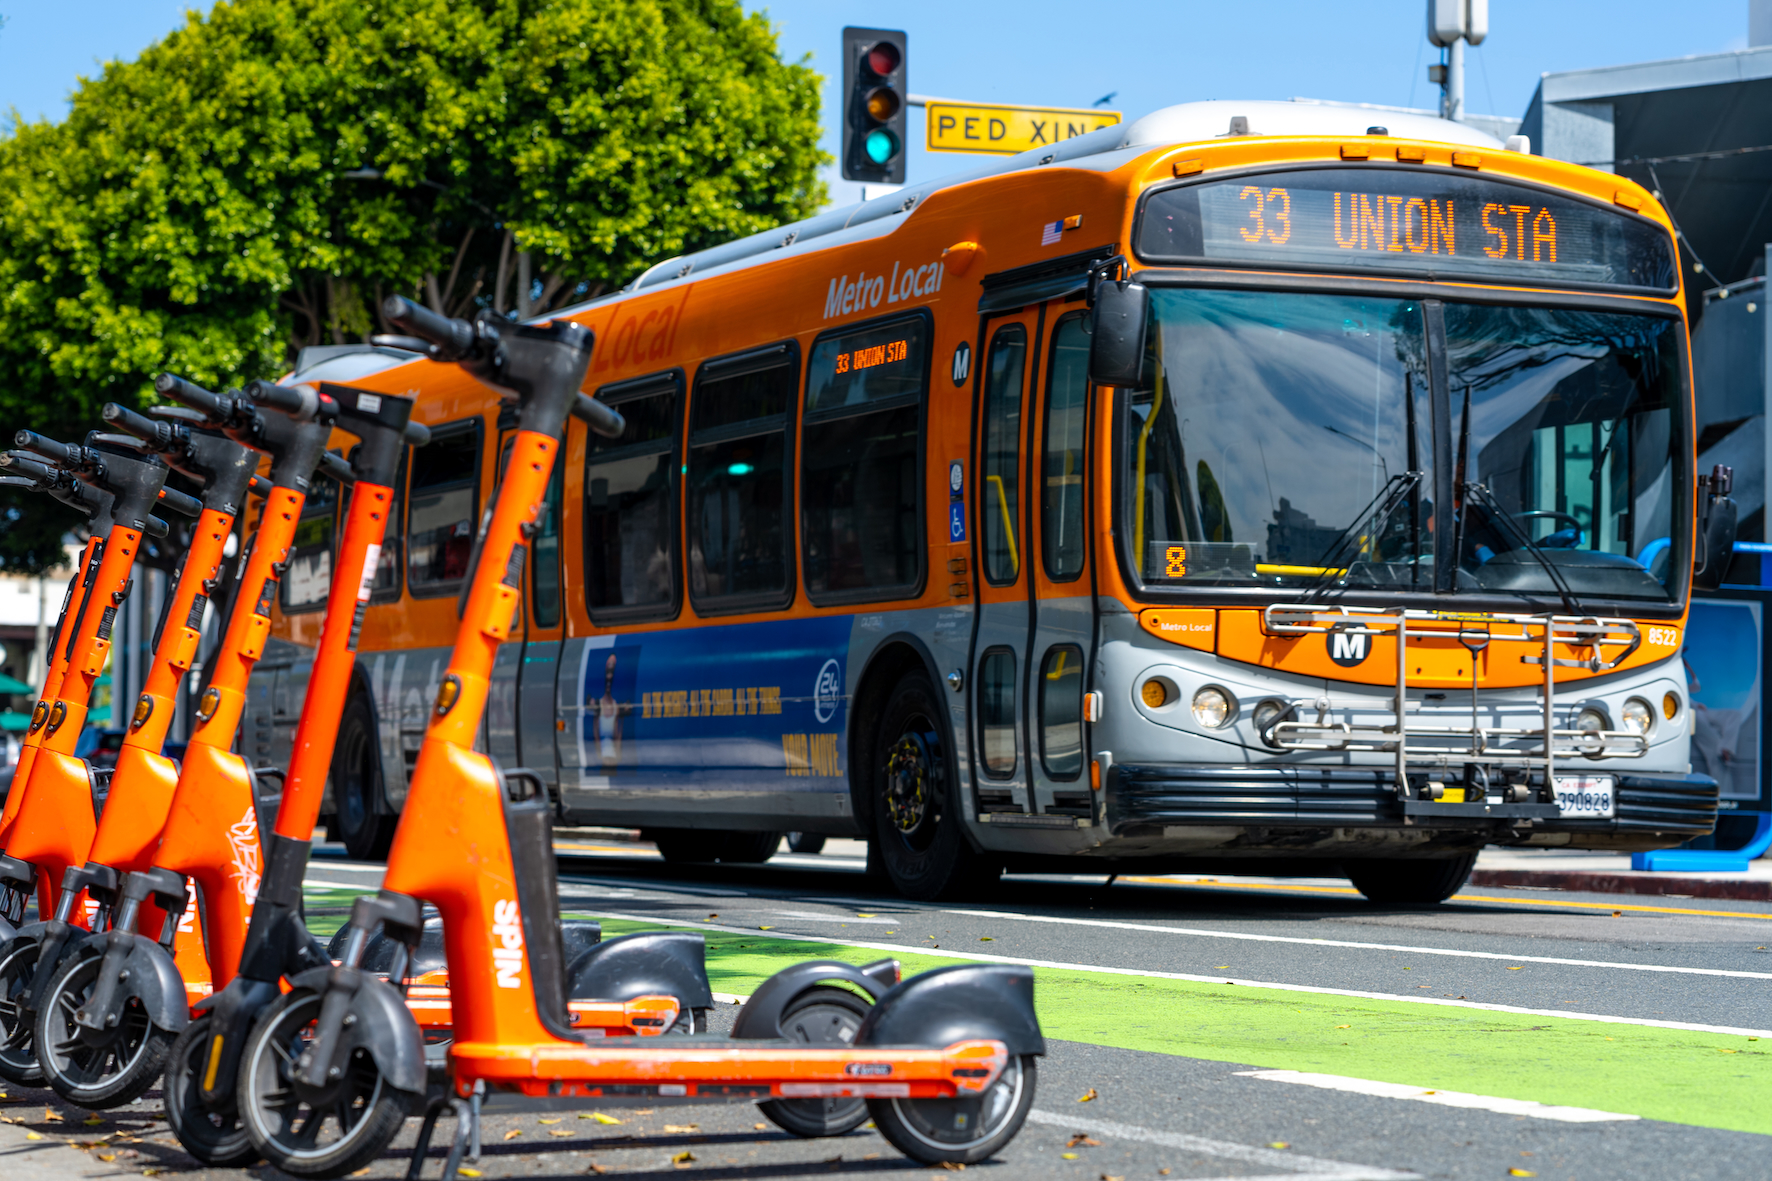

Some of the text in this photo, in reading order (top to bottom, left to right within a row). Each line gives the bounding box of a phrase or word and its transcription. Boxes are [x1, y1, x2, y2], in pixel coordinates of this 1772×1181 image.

[938, 115, 1108, 145] PED XIN
[1239, 185, 1557, 262] 33 UNION STA
[823, 260, 944, 319] Metro Local
[593, 282, 696, 374] Local
[836, 339, 908, 375] 33 UNION STA
[953, 348, 970, 381] M
[1166, 546, 1186, 577] 8
[1161, 622, 1212, 631] Metro Local
[1648, 627, 1676, 646] 8522
[1333, 632, 1365, 659] M
[820, 672, 838, 701] 24
[1559, 792, 1609, 811] 390828
[492, 899, 523, 989] SPIN
